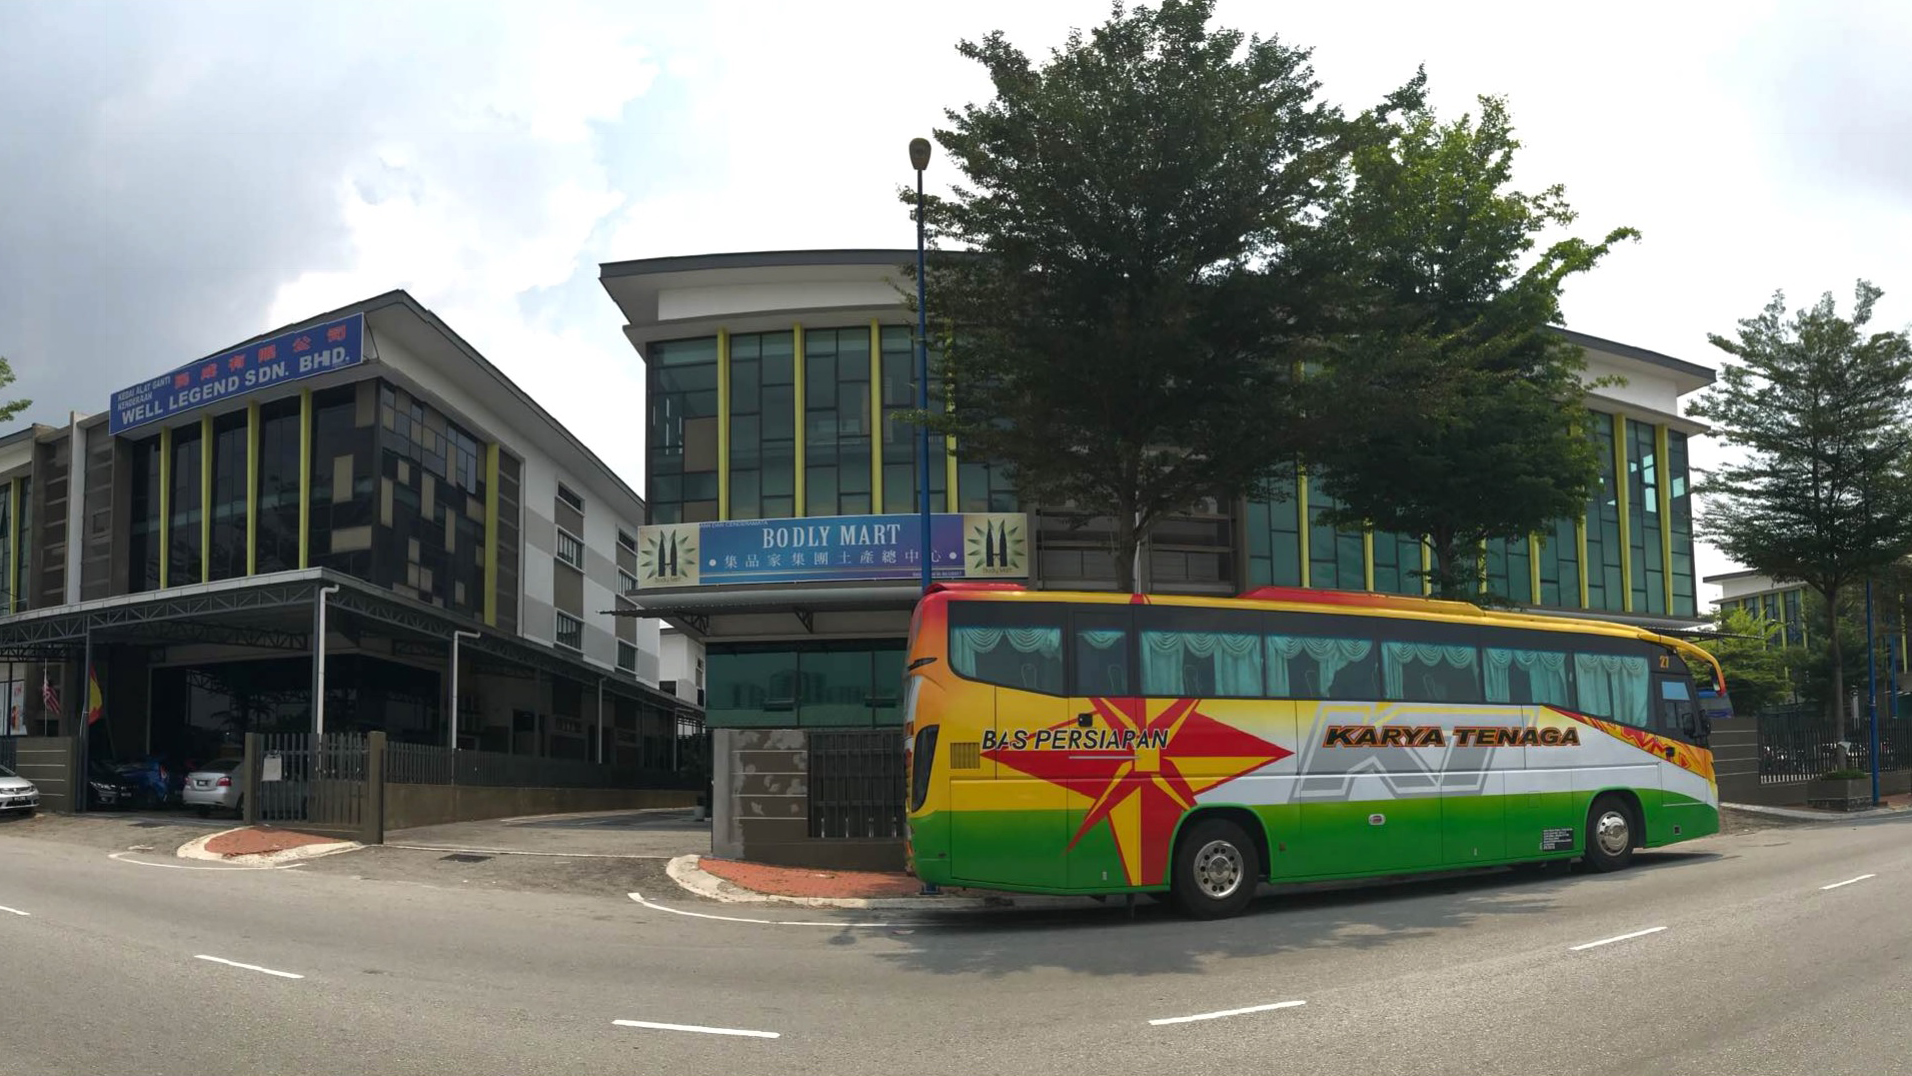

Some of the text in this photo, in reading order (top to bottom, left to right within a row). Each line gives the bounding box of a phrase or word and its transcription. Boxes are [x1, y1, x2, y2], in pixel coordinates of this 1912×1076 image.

[121, 346, 350, 425] WELL LEGEND SDN. BHD.
[136, 382, 151, 395] ALAT
[152, 376, 171, 389] GANTI
[762, 524, 900, 549] BODLY MART
[982, 729, 1169, 750] BAS PERSIARAN
[1322, 725, 1581, 748] KARYA TENAGA
